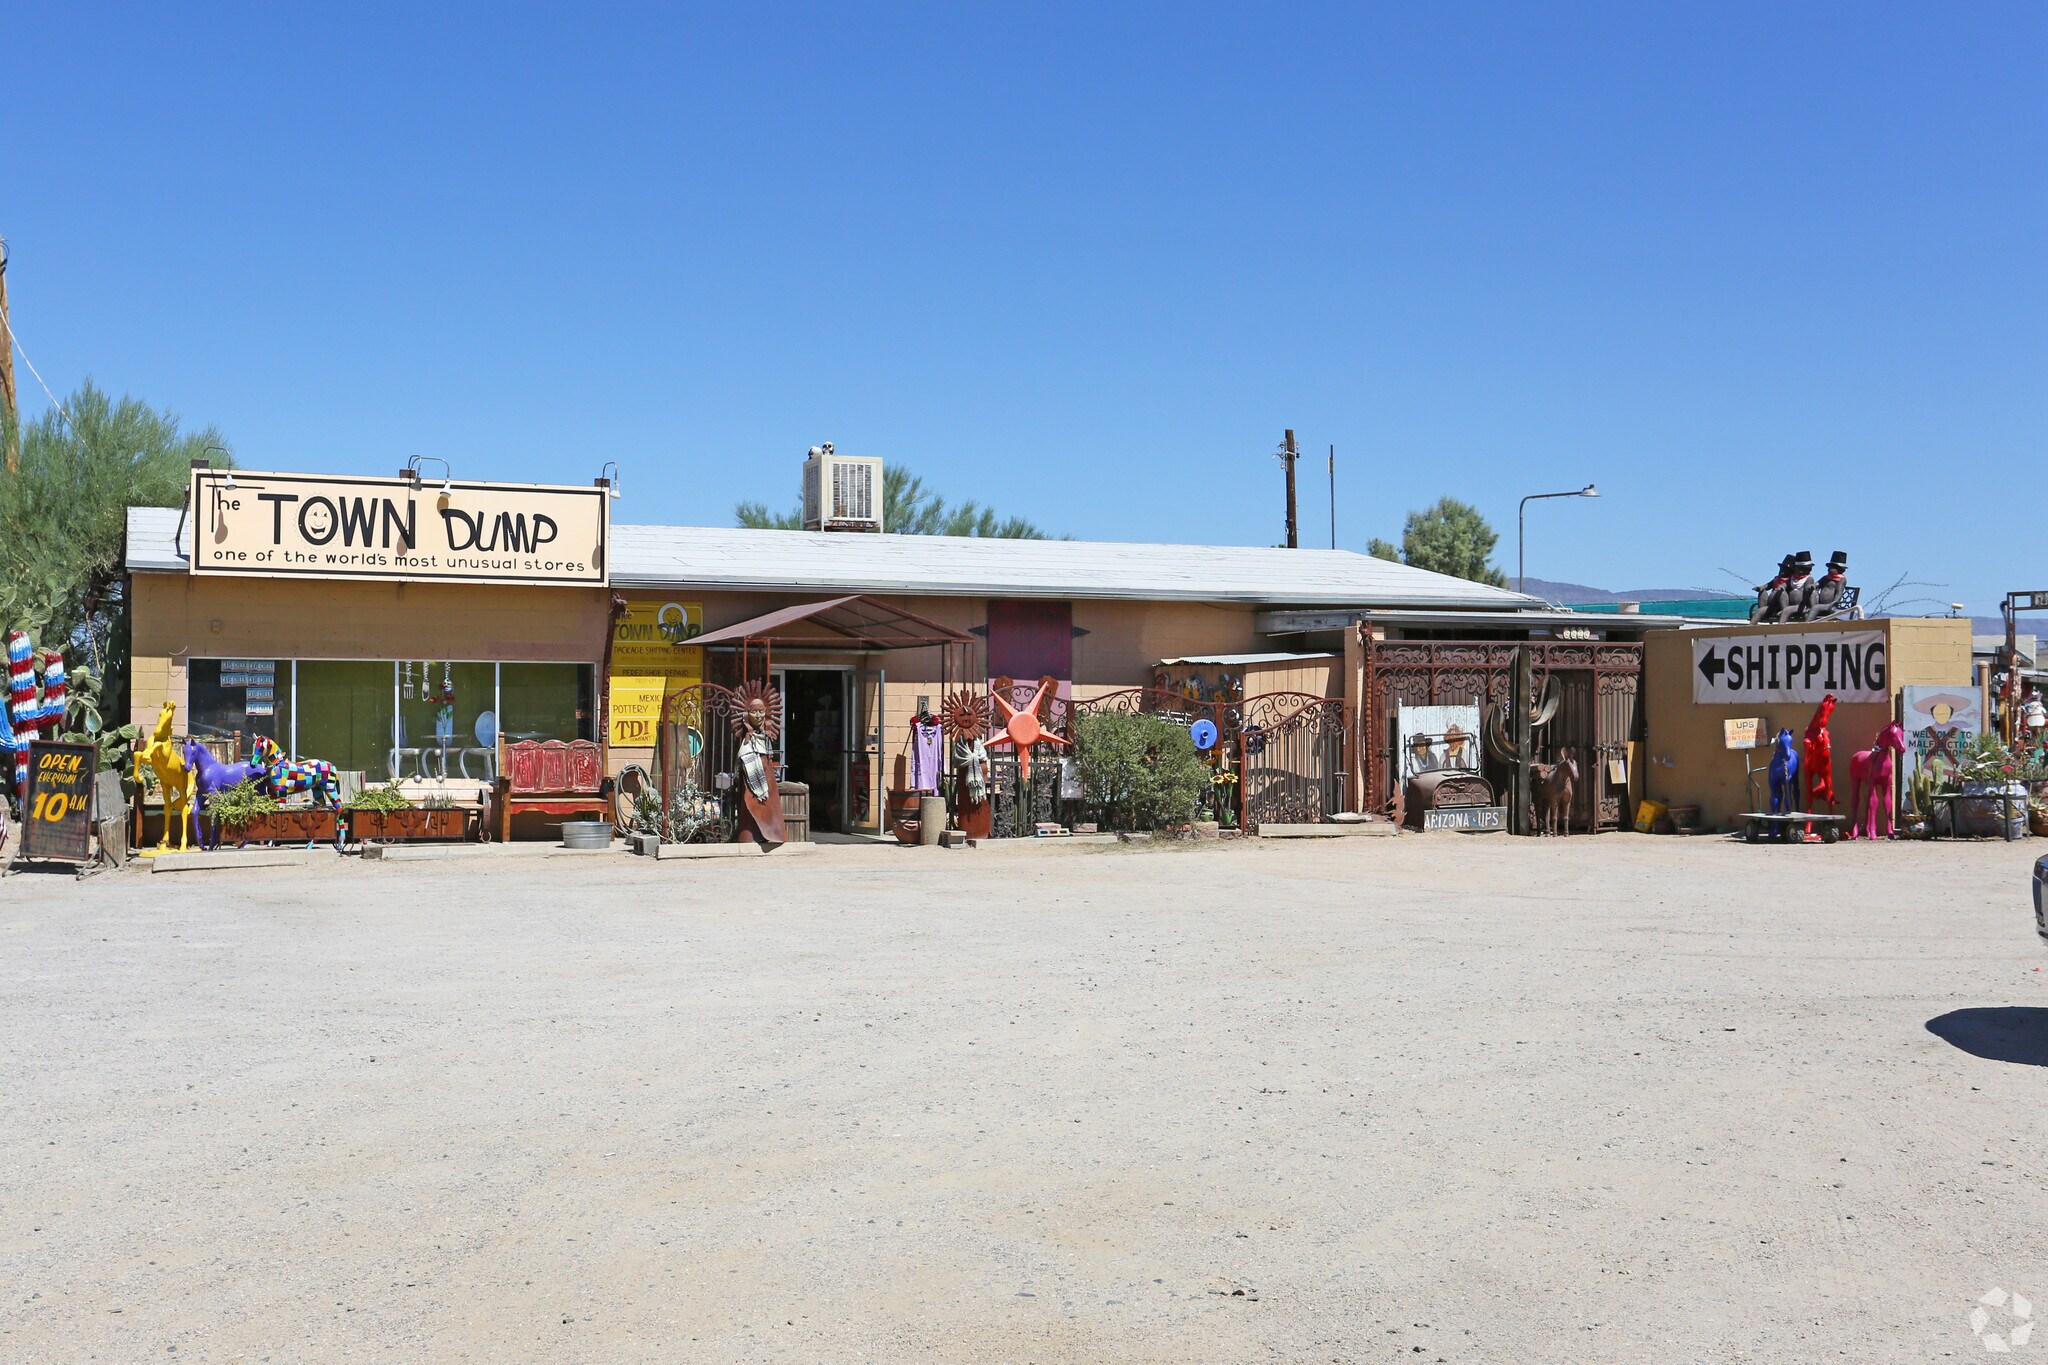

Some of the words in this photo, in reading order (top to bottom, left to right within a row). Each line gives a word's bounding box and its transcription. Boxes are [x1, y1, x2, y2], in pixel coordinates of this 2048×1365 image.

[206, 484, 265, 533] The
[258, 493, 415, 549] TOWN
[440, 508, 558, 553] DUMP
[213, 551, 247, 561] one
[256, 550, 274, 562] of
[284, 550, 318, 563] the
[326, 552, 387, 566] world's
[394, 555, 438, 567] most
[446, 557, 518, 570] unusual
[524, 559, 585, 572] stores
[614, 646, 644, 655] PACKAGE
[646, 646, 671, 655] SHIPPING
[673, 646, 697, 655] CENTER
[664, 669, 689, 677] REPAIR
[1727, 643, 1886, 691] SHIPPING
[613, 704, 649, 713] POTTERY
[615, 720, 650, 740] TDI
[1961, 731, 1973, 739] TO
[39, 753, 83, 771] OPEN
[37, 771, 77, 788] EVERYDAY
[32, 791, 69, 823] 10
[69, 794, 88, 812] AM
[1424, 812, 1470, 829] ARIZONA
[1477, 811, 1500, 827] UPS
